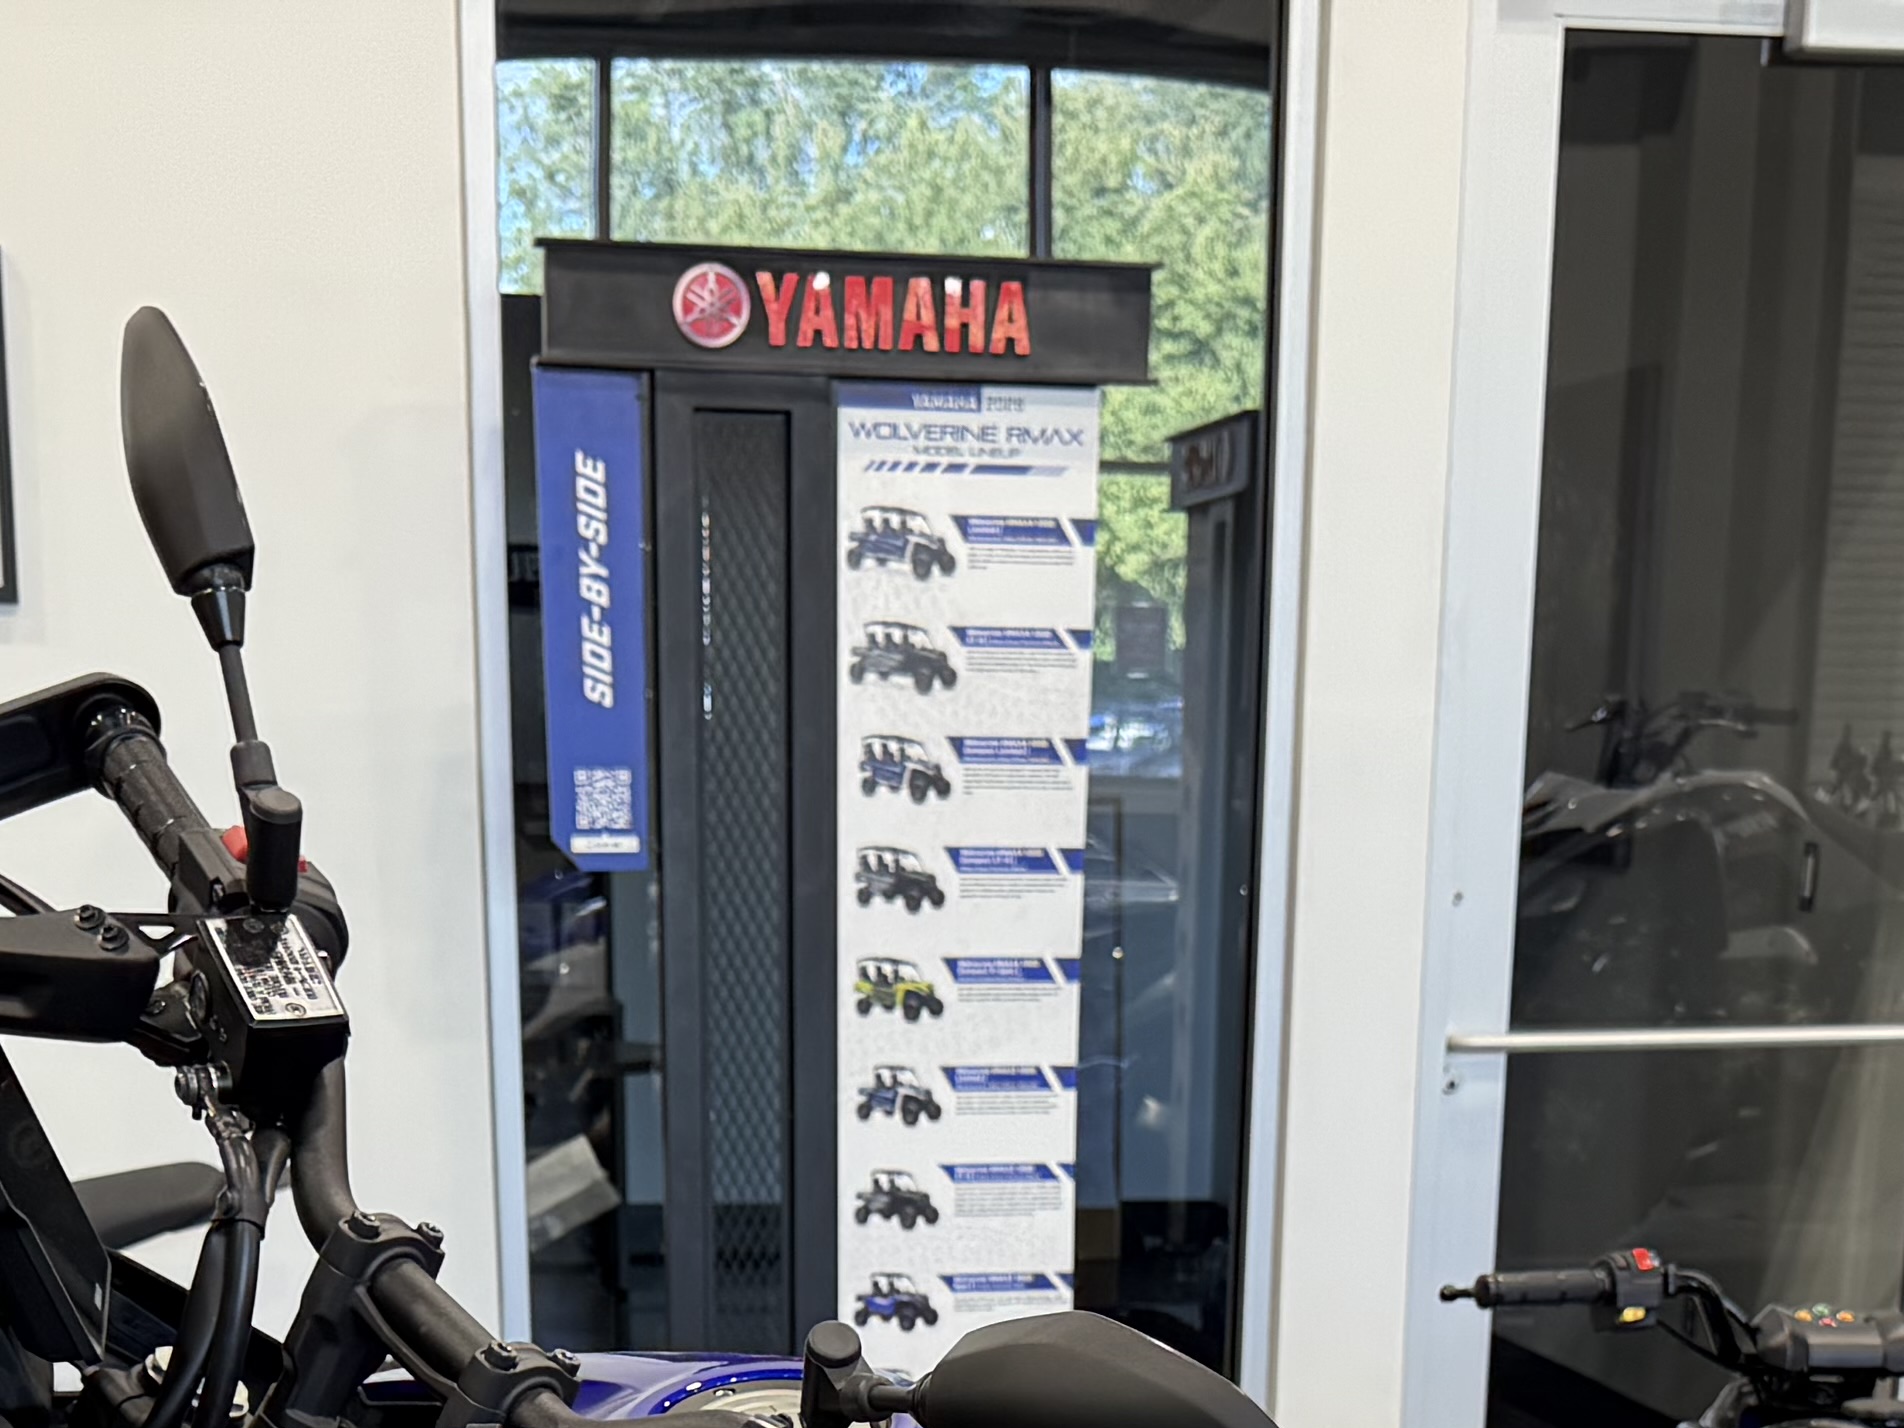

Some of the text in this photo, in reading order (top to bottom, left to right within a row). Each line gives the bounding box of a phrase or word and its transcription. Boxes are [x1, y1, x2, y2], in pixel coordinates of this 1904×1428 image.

[755, 270, 1032, 356] YAMAHA
[848, 421, 1084, 447] WOLVERINE RMAX
[574, 448, 615, 710] SIDE-BY-SIDE
